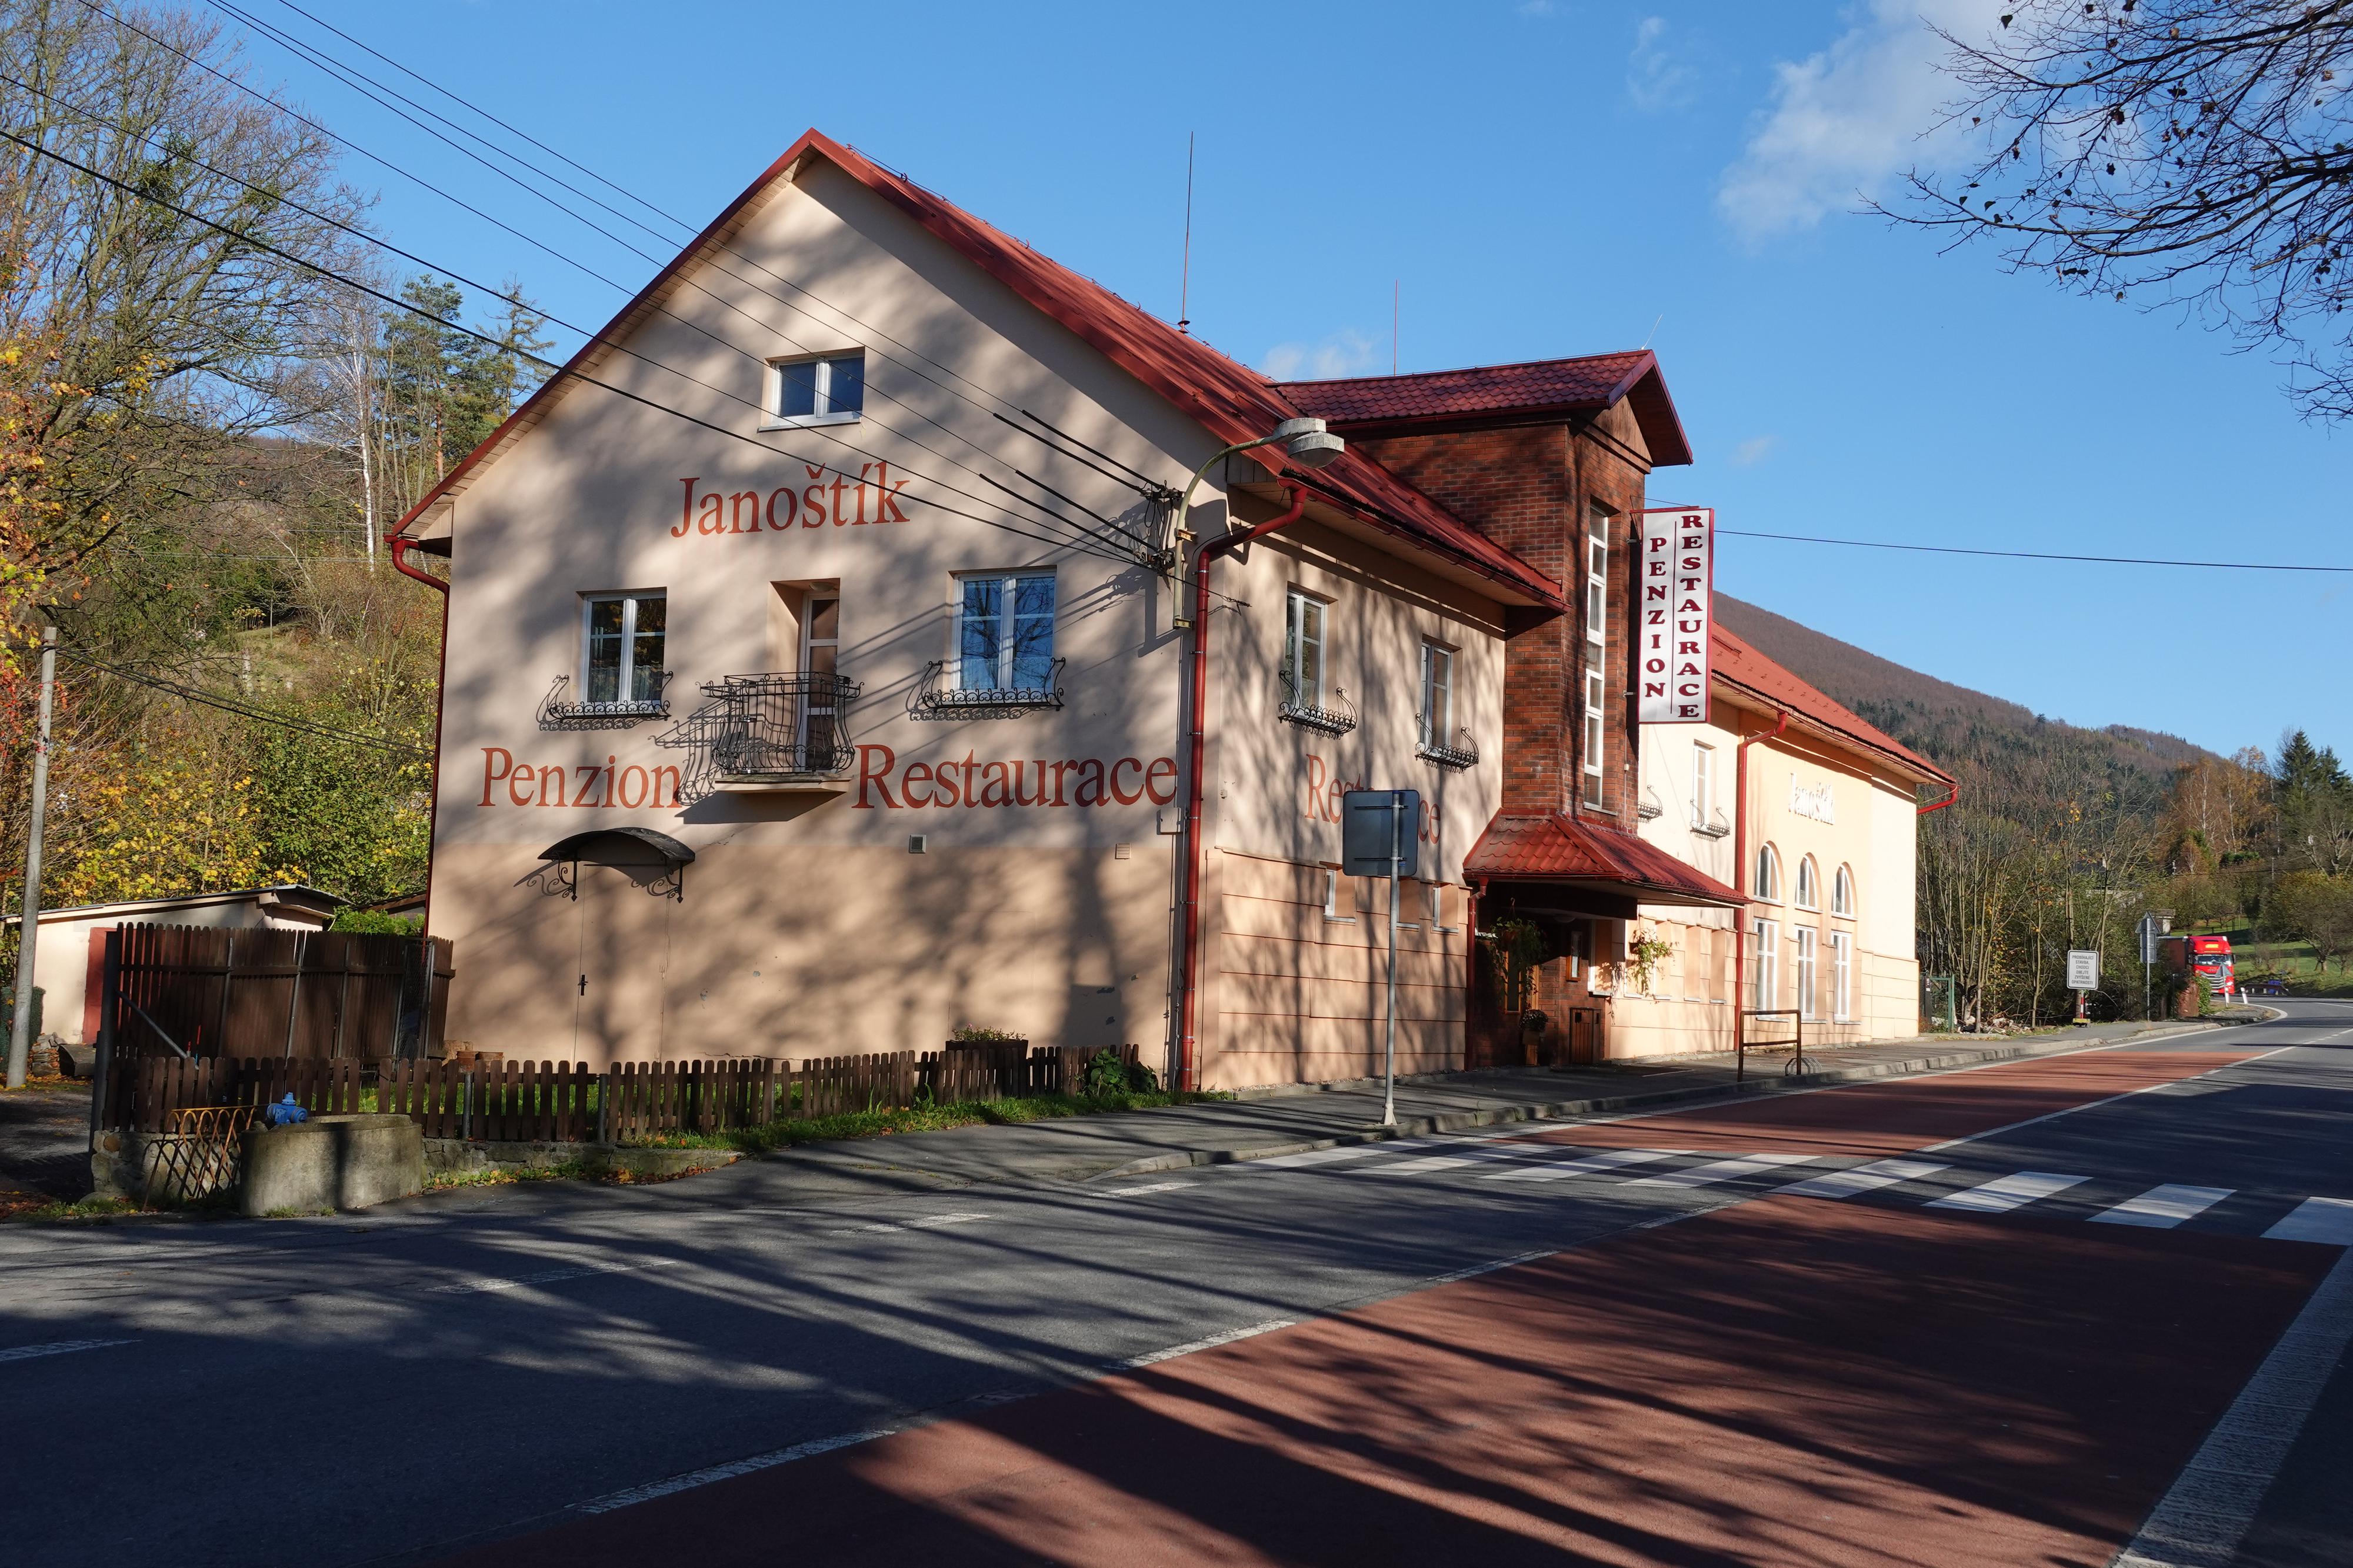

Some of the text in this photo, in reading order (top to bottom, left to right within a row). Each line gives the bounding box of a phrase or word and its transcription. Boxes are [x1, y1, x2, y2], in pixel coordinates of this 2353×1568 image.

[671, 460, 911, 538] Janoštík
[1645, 537, 1668, 698] PENZION
[1676, 515, 1705, 718] RESTAURACE
[476, 744, 1176, 809] Penzion Restaurace
